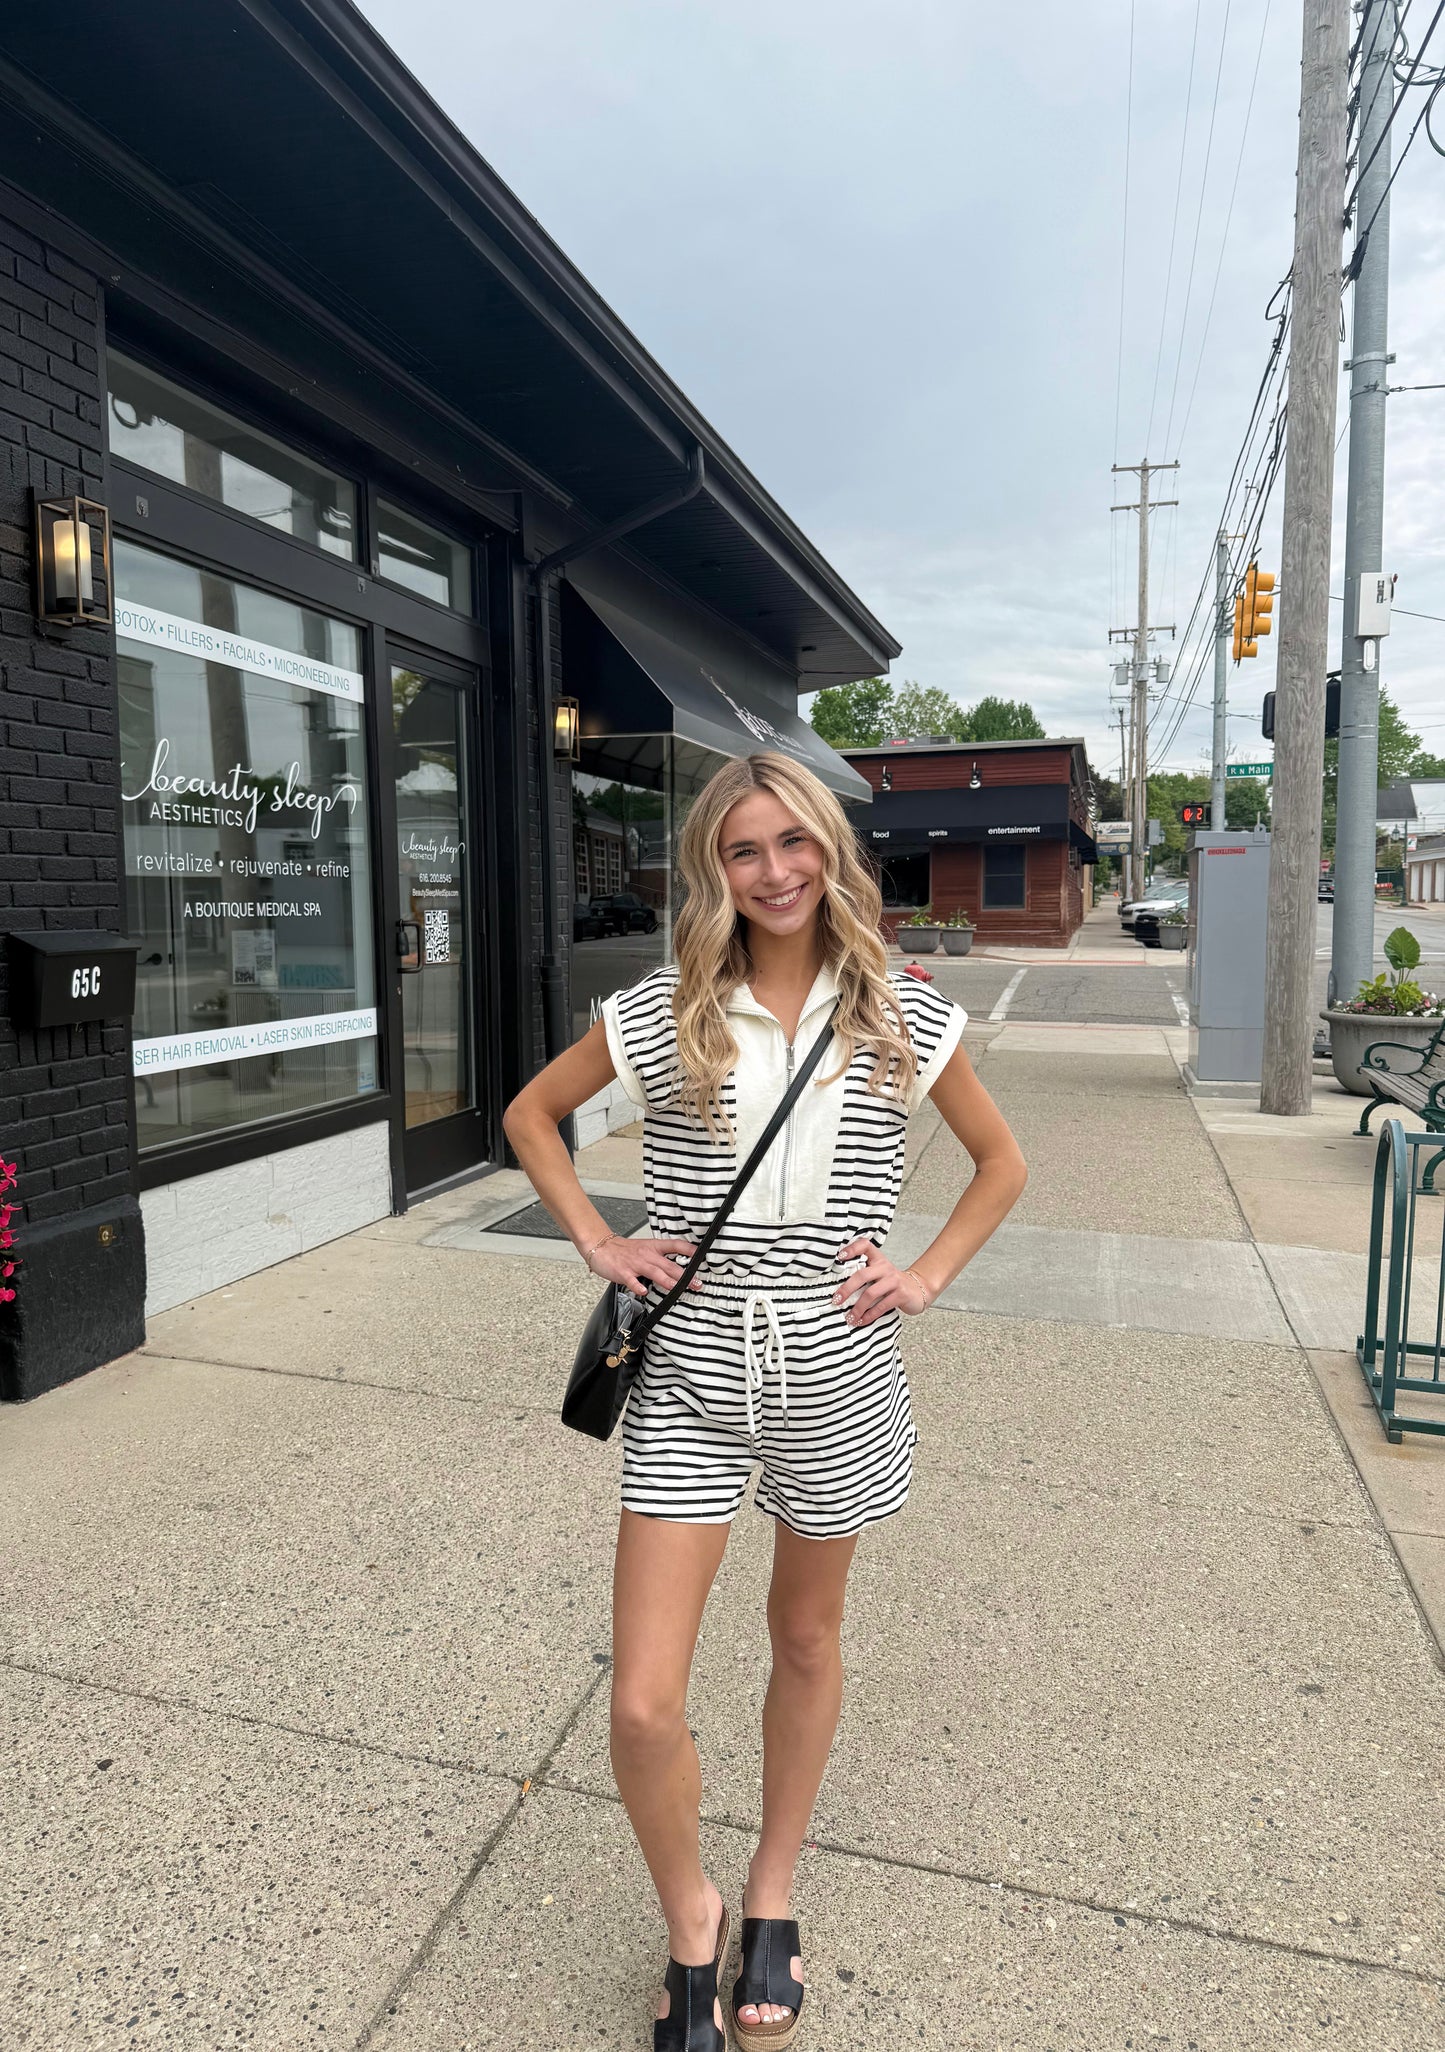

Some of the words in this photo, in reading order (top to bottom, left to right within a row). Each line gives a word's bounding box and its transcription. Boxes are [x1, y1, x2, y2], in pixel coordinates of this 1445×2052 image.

[167, 624, 214, 651] FILLERS
[223, 641, 266, 667] FACIALS
[274, 657, 350, 691] MICRONEEDLING
[1248, 765, 1270, 775] Main
[121, 738, 266, 834] beauty
[270, 761, 357, 840] sleep
[150, 802, 243, 827] AESTHETICS
[1196, 807, 1203, 820] 2
[872, 831, 890, 839] food
[928, 829, 948, 837] spirits
[988, 825, 1041, 835] entertainment
[401, 832, 439, 862] beauty
[439, 836, 466, 863] sleep
[136, 852, 213, 873] revitalize
[230, 858, 302, 877] rejuvenate
[316, 861, 350, 878] refine
[183, 902, 193, 918] A
[196, 902, 254, 919] BOUTIQUE
[256, 902, 302, 917] MEDICAL
[303, 902, 322, 917] SPA
[72, 965, 101, 999] 65C
[163, 1042, 192, 1061] HAIR
[195, 1035, 248, 1056] REMOVAL
[257, 1029, 289, 1046] LASER
[290, 1024, 313, 1041] SKIN
[314, 1016, 373, 1037] RESURFACING
